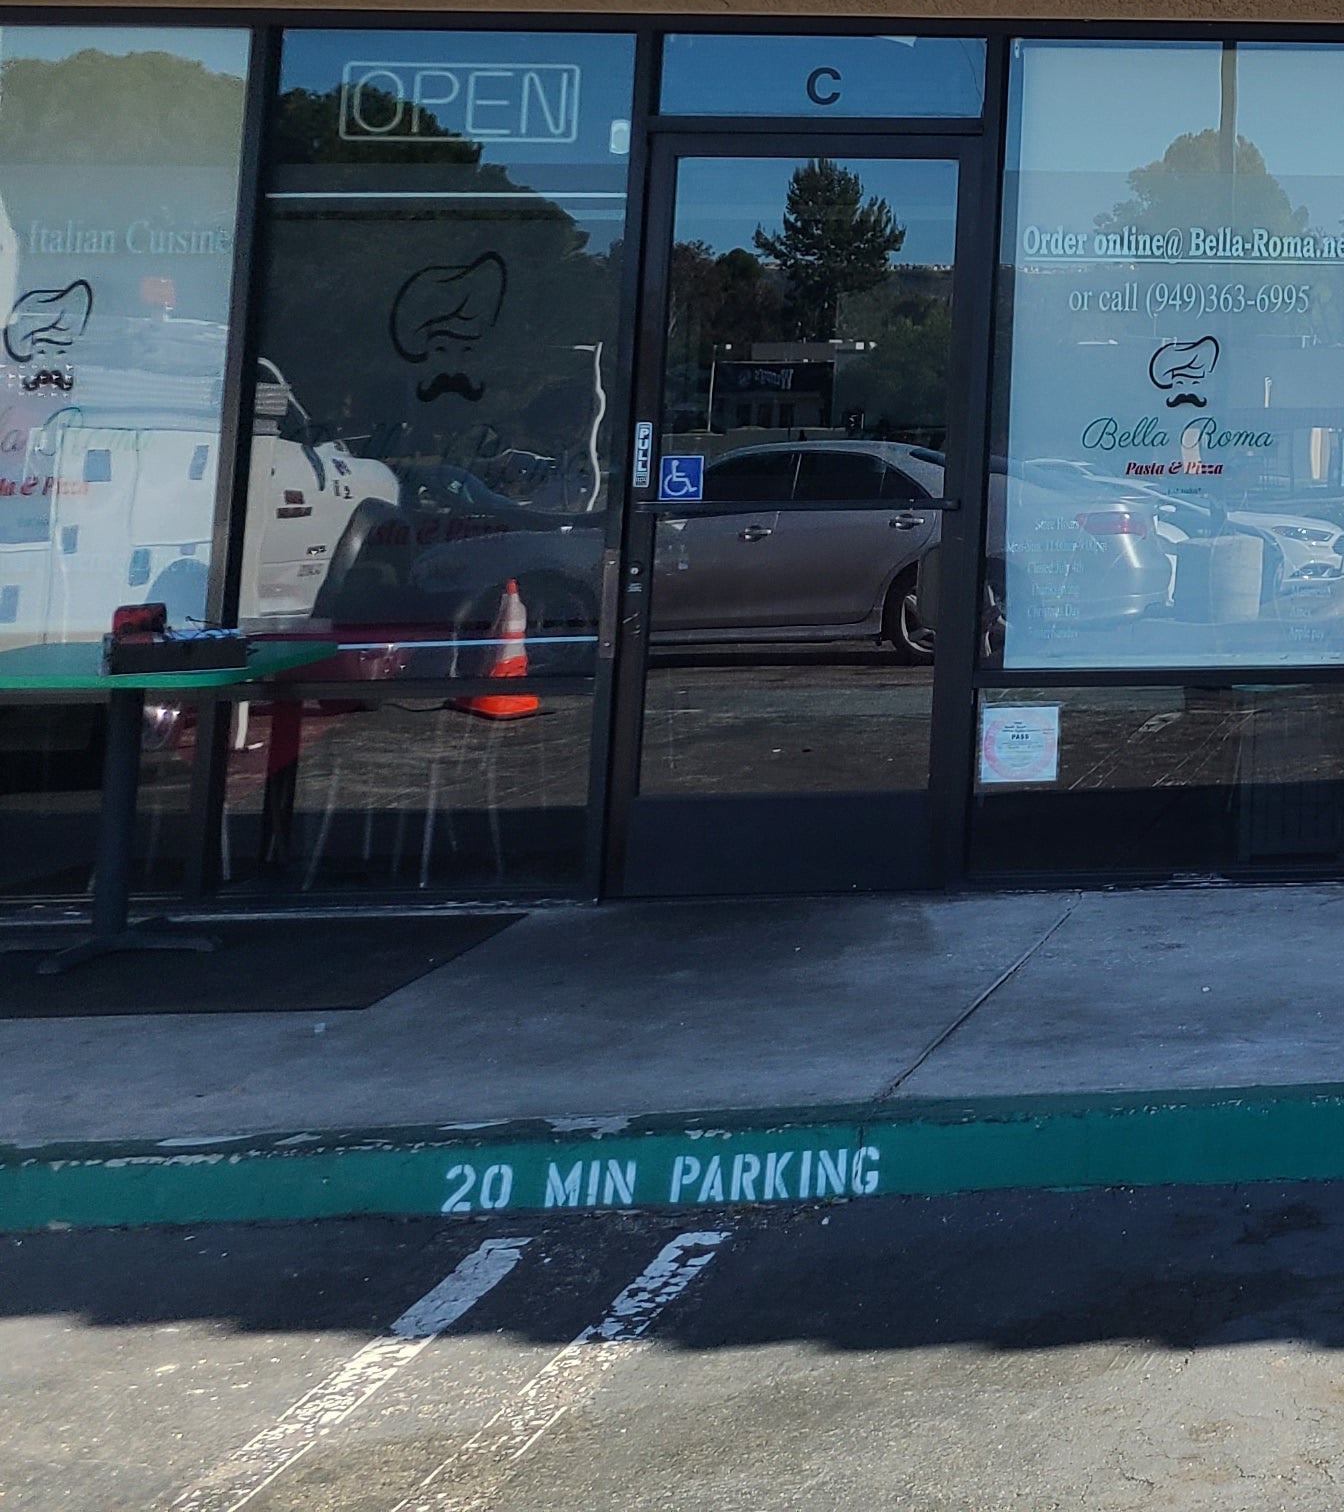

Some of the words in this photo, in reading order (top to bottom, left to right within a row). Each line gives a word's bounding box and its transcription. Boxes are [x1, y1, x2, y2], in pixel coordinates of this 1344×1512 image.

[352, 70, 568, 136] OPEN
[806, 67, 842, 105] C
[28, 220, 116, 255] Italian
[1023, 225, 1088, 255] Order
[1069, 291, 1093, 311] or
[1099, 283, 1138, 312] call
[1146, 283, 1309, 317] (949)363-6995
[637, 427, 649, 474] PULL
[1082, 416, 1170, 450] Bella
[1181, 416, 1273, 449] Roma
[1125, 461, 1165, 476] Pasta
[1184, 461, 1224, 476] Pizza
[441, 1163, 513, 1213] 20
[545, 1159, 637, 1208] MIN
[670, 1146, 881, 1204] PARKING
